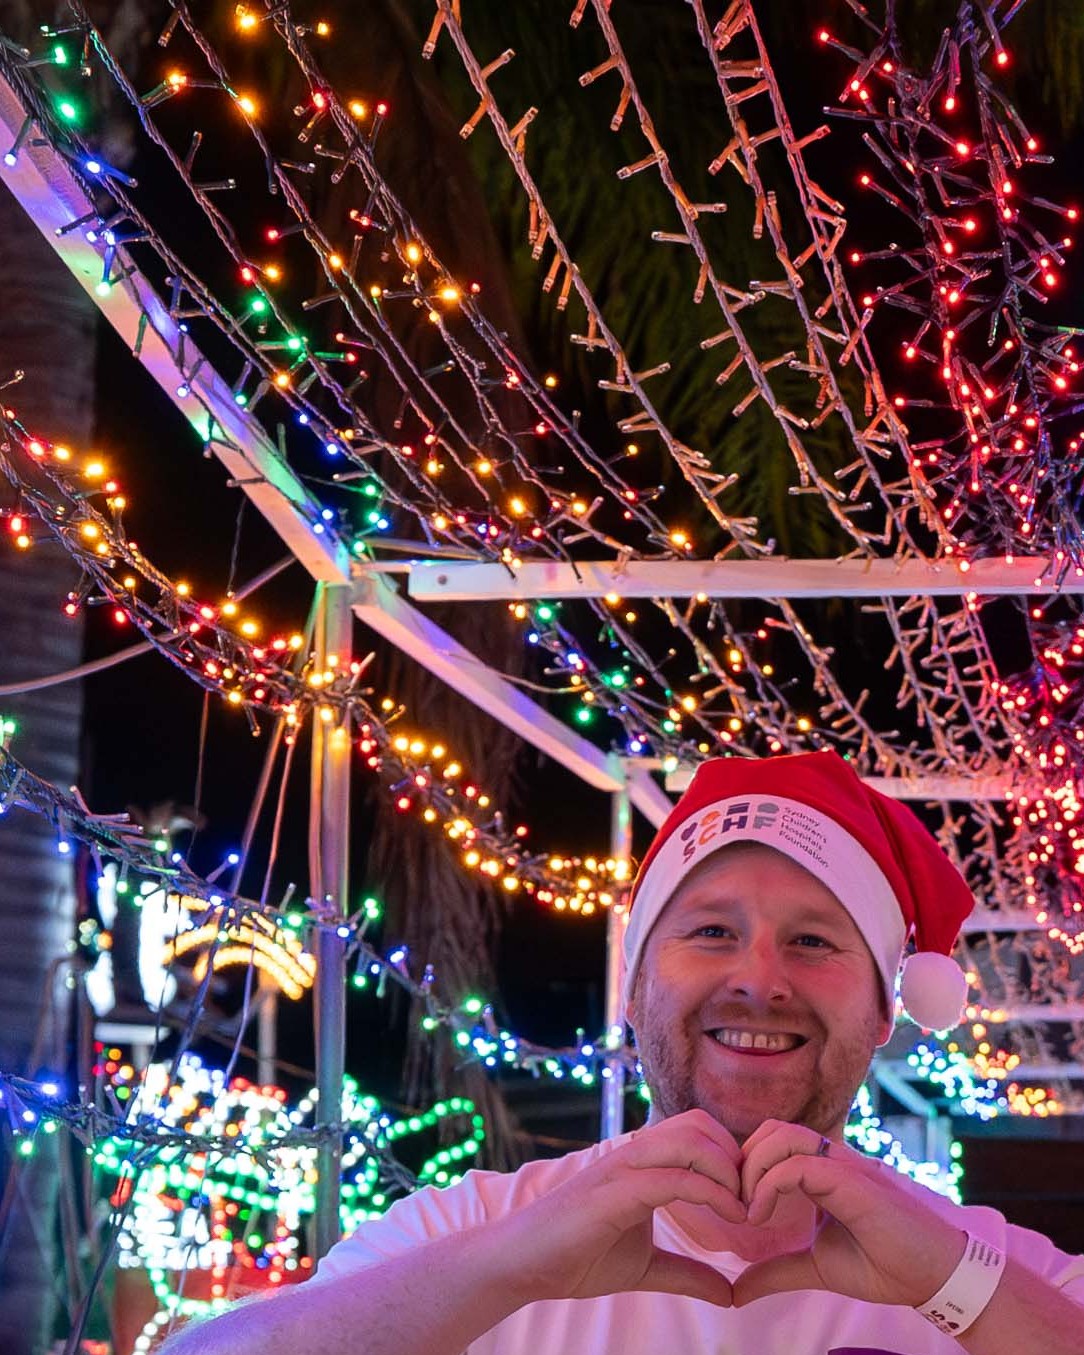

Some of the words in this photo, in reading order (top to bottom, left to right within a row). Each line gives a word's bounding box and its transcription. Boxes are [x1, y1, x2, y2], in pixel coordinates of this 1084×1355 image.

[782, 814, 827, 843] Children's
[784, 806, 820, 827] Sydney
[683, 815, 777, 865] SCHF
[778, 829, 829, 868] Foundation
[780, 822, 823, 851] Hospitals
